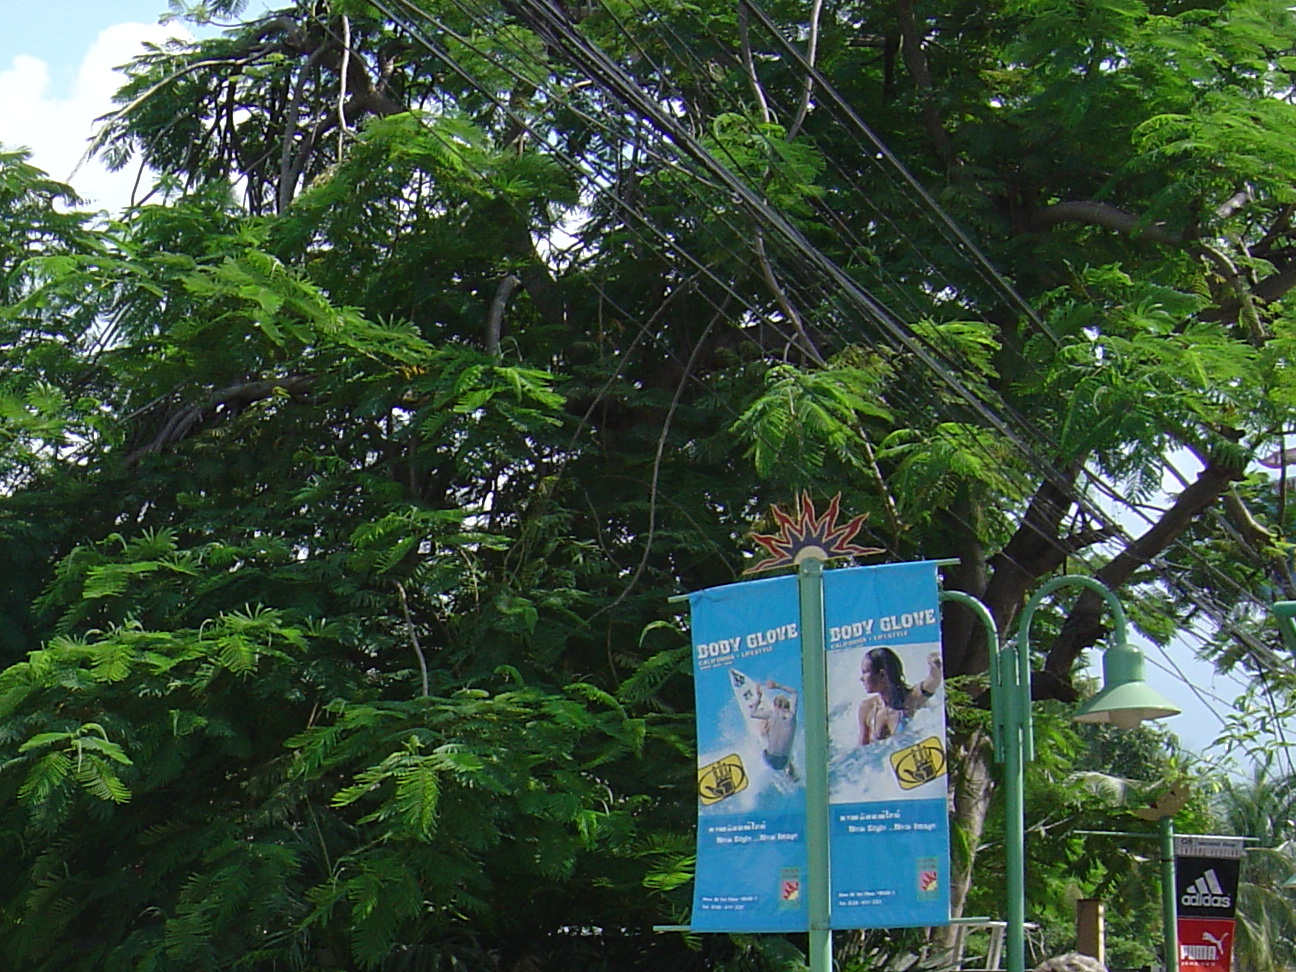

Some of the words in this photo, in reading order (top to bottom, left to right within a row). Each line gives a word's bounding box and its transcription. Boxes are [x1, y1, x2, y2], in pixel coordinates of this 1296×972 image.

[829, 619, 874, 642] BODY
[879, 609, 936, 632] GLOVE
[696, 637, 741, 659] BODY
[746, 623, 798, 649] GLOVE
[1181, 893, 1231, 908] adidas
[1180, 945, 1217, 960] PUMA
